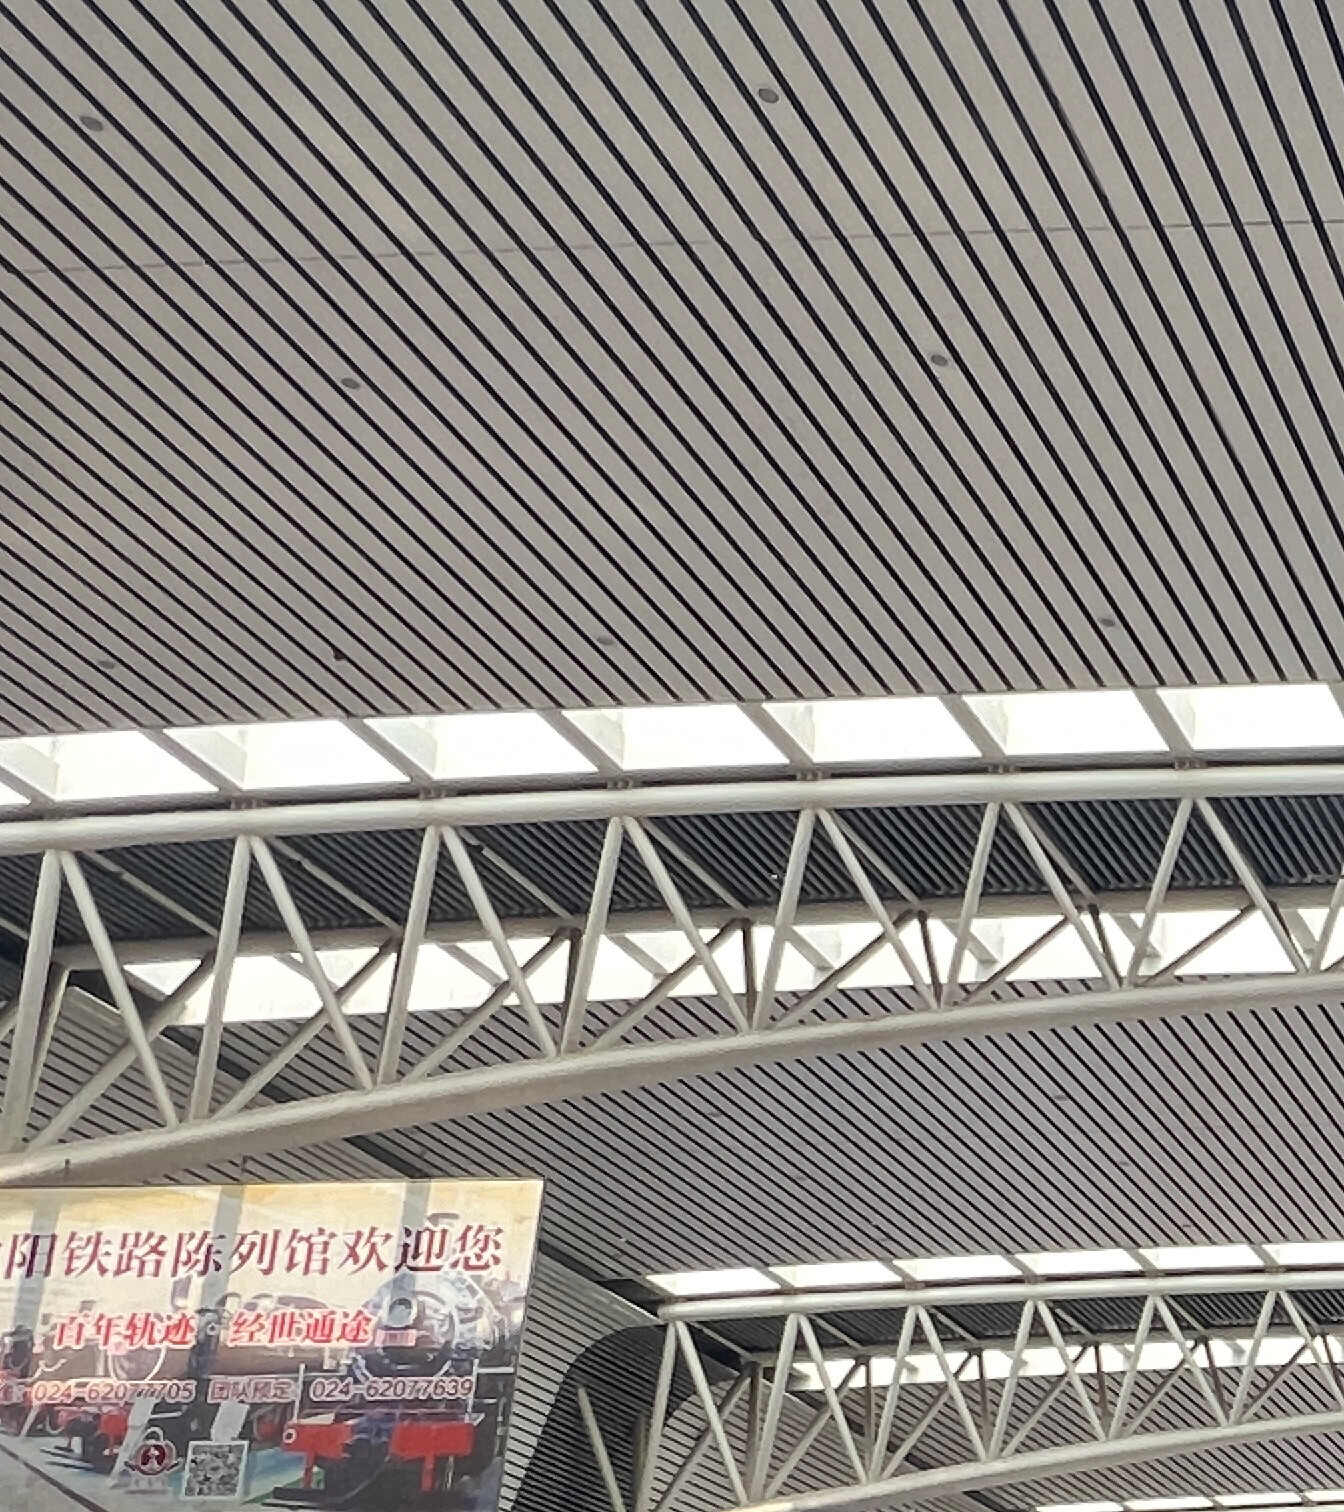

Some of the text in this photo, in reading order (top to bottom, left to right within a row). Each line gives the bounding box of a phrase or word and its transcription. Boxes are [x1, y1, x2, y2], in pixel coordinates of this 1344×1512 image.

[0, 1224, 504, 1280] 阳铁路陈列馆欢迎您
[54, 1310, 197, 1348] 百年轨迹
[311, 1378, 475, 1400] 024-62077639
